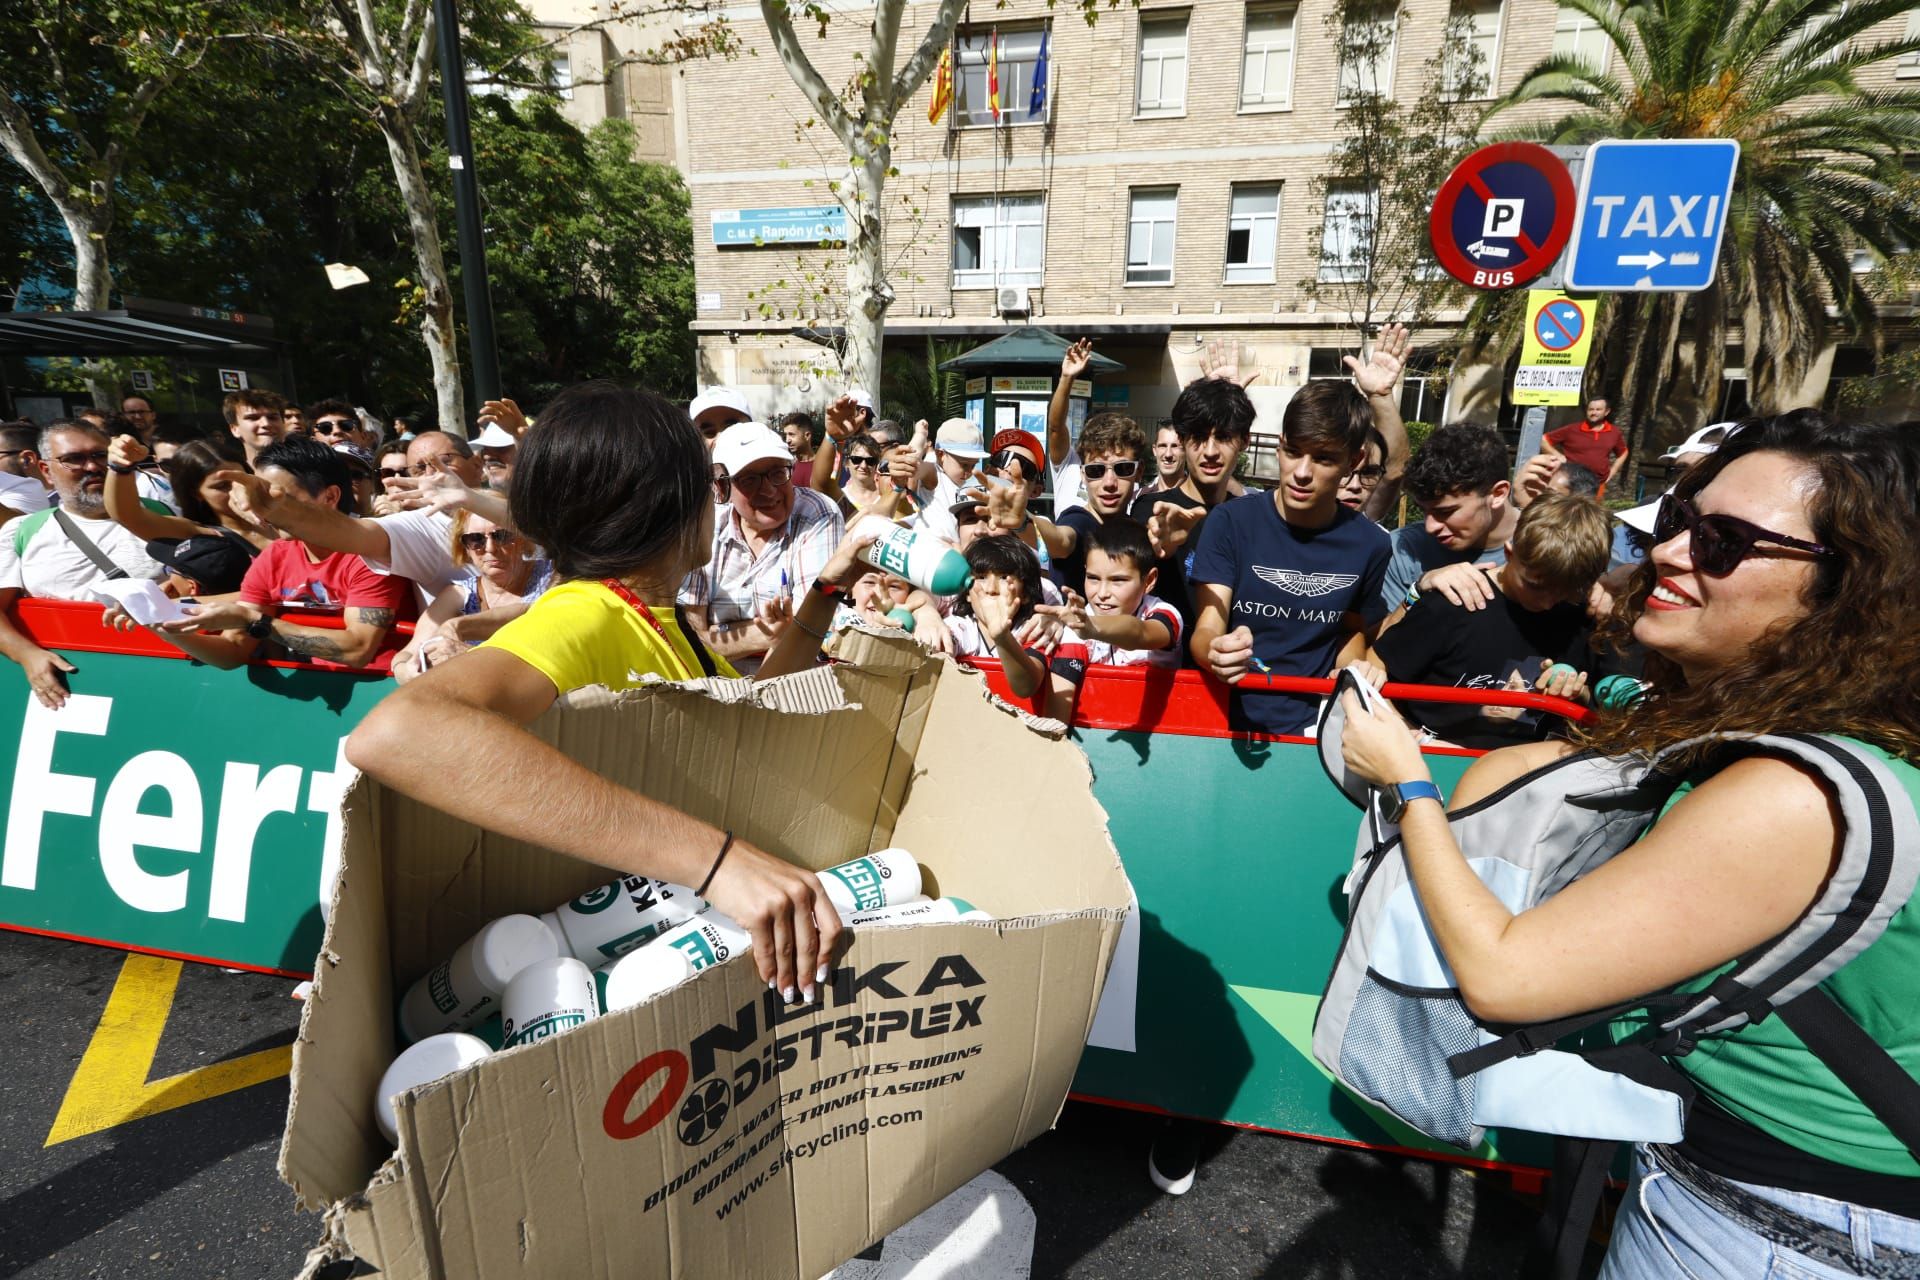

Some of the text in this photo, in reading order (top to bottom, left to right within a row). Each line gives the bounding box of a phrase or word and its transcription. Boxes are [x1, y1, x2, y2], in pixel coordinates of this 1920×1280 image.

[1491, 204, 1514, 232] P
[1592, 195, 1720, 239] TAXI
[762, 225, 805, 238] Ramón
[805, 227, 813, 240] y
[1473, 270, 1514, 287] BUS
[1232, 600, 1344, 624] ASTON MART
[702, 926, 719, 948] KERN
[643, 1043, 983, 1213] BIDONES-WATER BOTTLES-BIDONS
[692, 1070, 966, 1206] BORRACCE-TRINKFLASCHEN
[716, 1107, 924, 1222] www.siecycling.com
